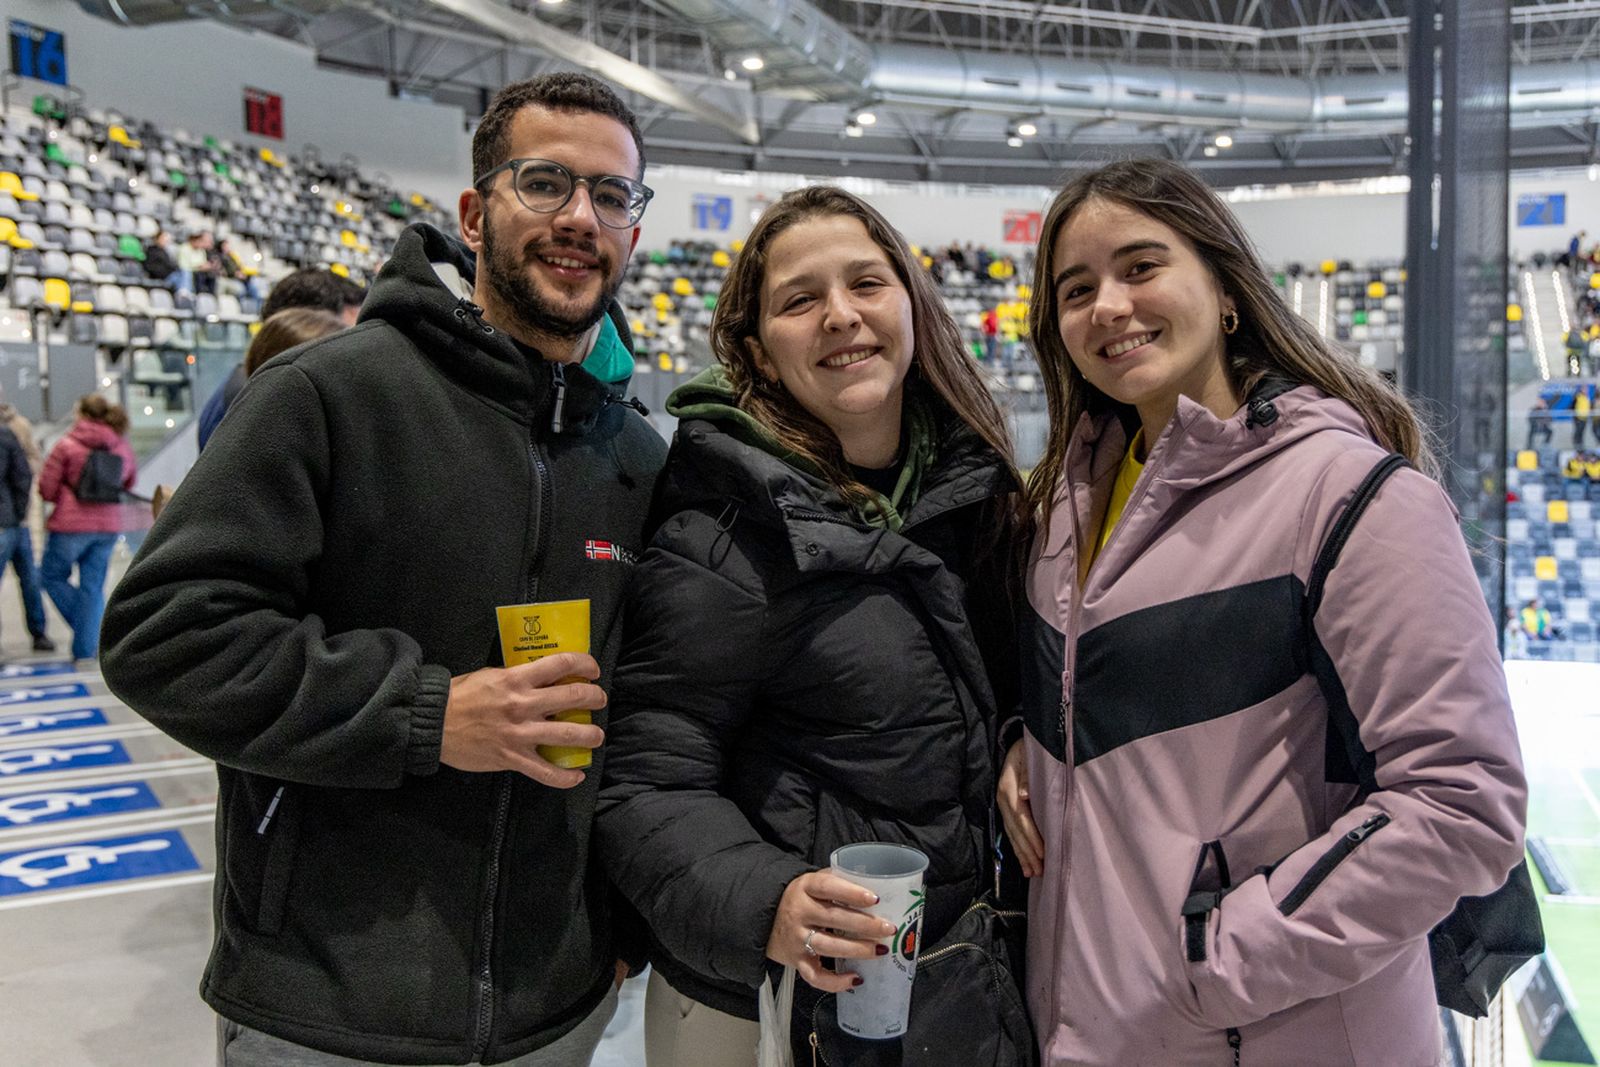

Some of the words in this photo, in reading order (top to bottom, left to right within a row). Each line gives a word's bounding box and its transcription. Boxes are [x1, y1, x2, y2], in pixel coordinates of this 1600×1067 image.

[18, 30, 67, 86] 16
[695, 195, 732, 231] 19
[1518, 194, 1566, 225] 21
[1003, 211, 1042, 244] 20
